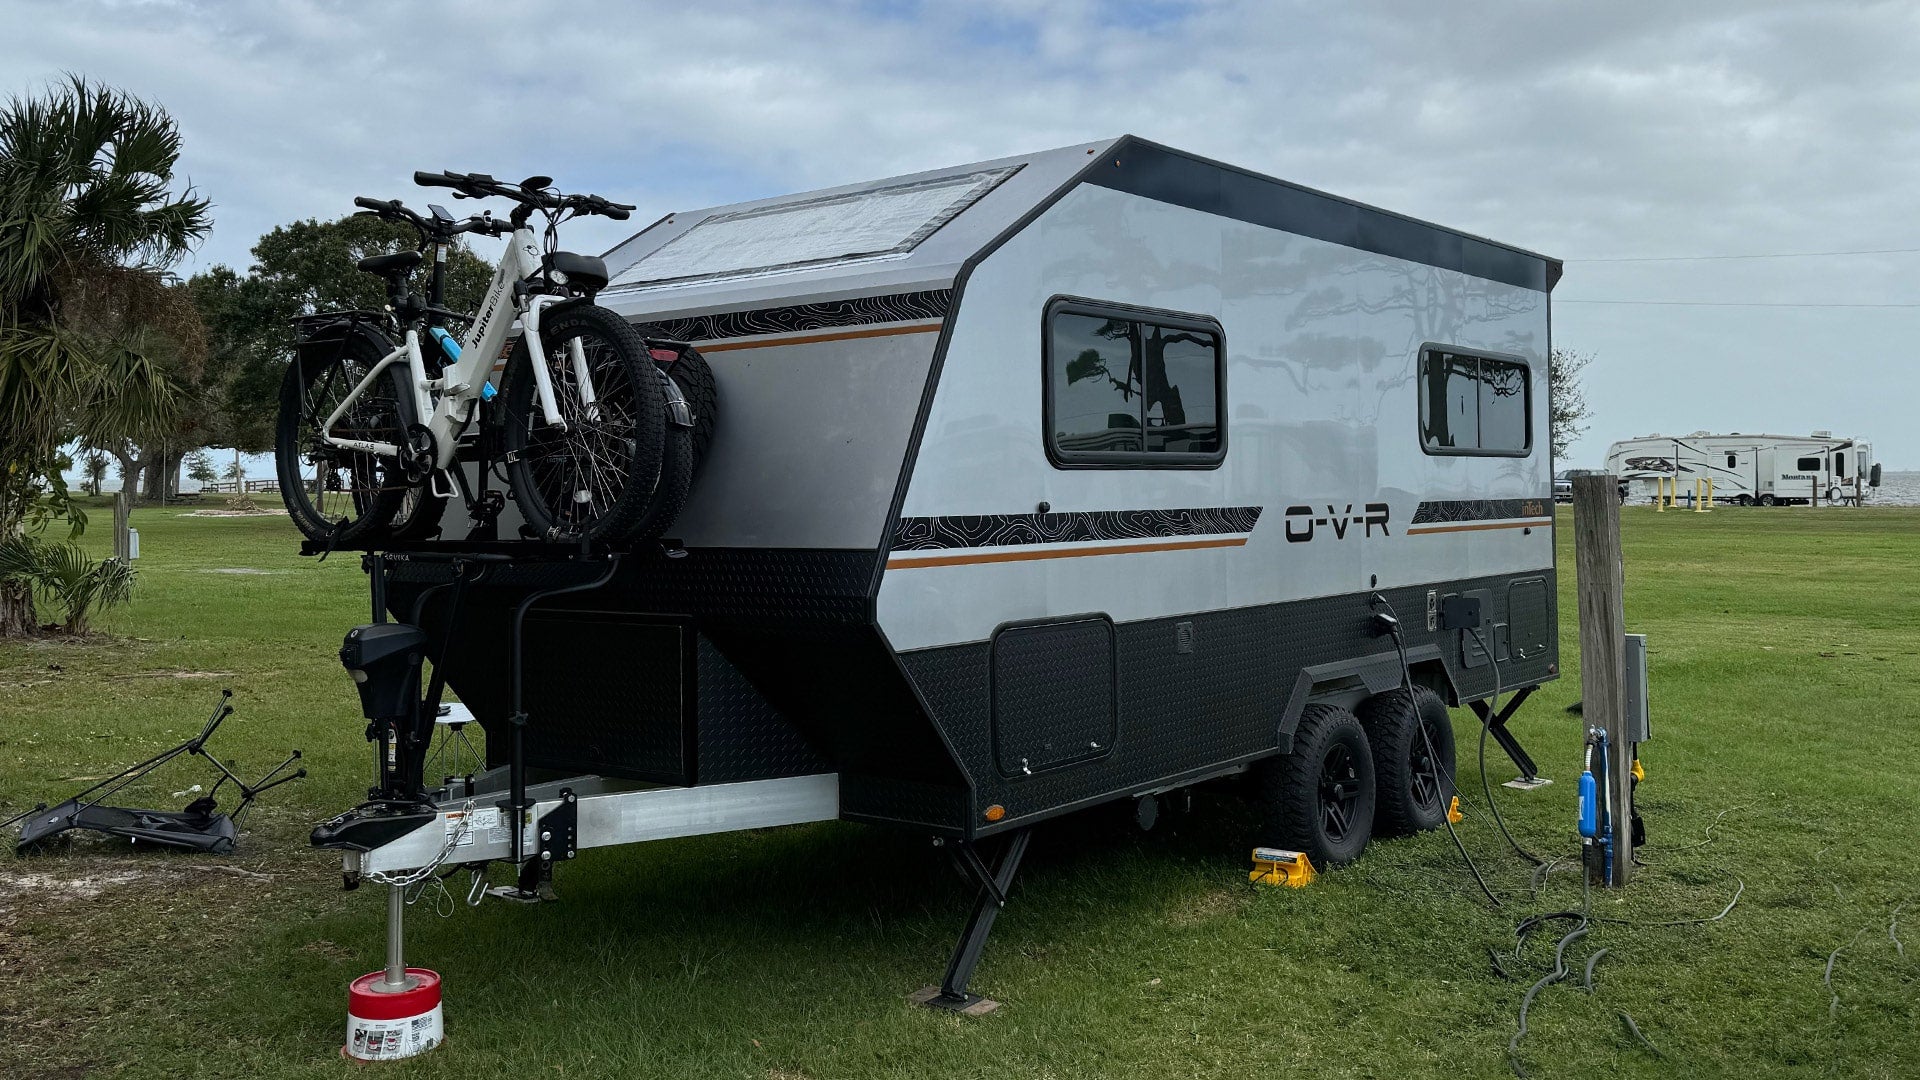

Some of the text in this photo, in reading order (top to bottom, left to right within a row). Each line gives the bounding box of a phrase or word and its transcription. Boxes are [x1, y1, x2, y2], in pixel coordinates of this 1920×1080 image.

[470, 281, 506, 350] JupiterBike
[353, 442, 375, 450] ATLAS
[1781, 473, 1814, 481] Montan
[1521, 500, 1543, 516] inTech
[1285, 502, 1390, 543] O-V-R
